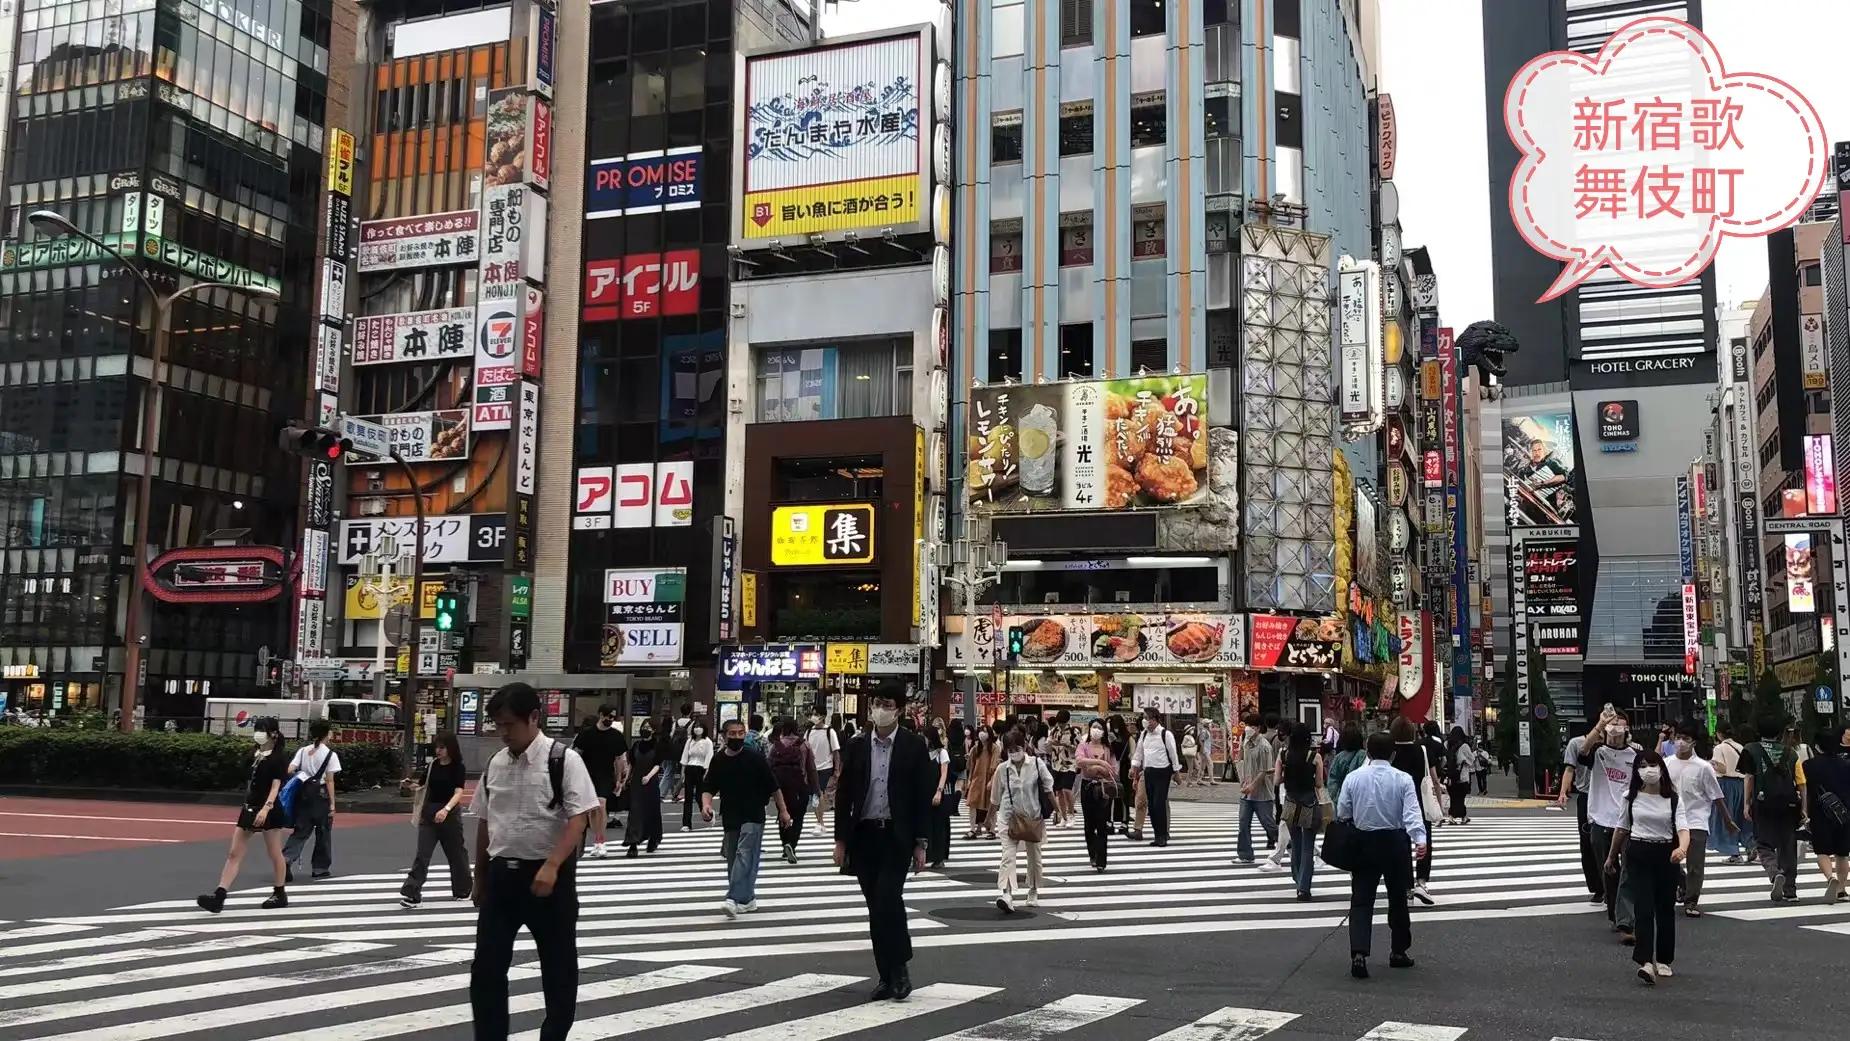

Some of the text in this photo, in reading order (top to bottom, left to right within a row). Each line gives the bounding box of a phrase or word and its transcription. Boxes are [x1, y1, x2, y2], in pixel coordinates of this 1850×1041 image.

[535, 118, 546, 174] アイフル
[764, 112, 901, 148] だんまや水産
[488, 199, 505, 254] 専門店
[434, 235, 474, 258] 本陣
[589, 261, 698, 298] アイフル
[633, 301, 651, 313] 5F
[403, 323, 465, 357] 本陣
[525, 321, 537, 361] アコム
[1591, 357, 1696, 374] HOTEL GRACERY
[489, 388, 507, 401] 酒
[1077, 445, 1092, 464] 光
[579, 472, 692, 510] アコム
[1076, 490, 1092, 504] 4F
[585, 518, 601, 528] 3F
[827, 513, 866, 555] 集
[1769, 522, 1806, 530] CENTRAL
[1680, 511, 1691, 573] カラオケランド
[611, 579, 653, 596] BUY
[627, 629, 677, 647] SELL
[1228, 616, 1240, 649] かつ丼
[1514, 554, 1528, 690] GODZILLA ROAD
[1685, 597, 1696, 656] 新宿東宝ビル店
[848, 648, 864, 669] 集
